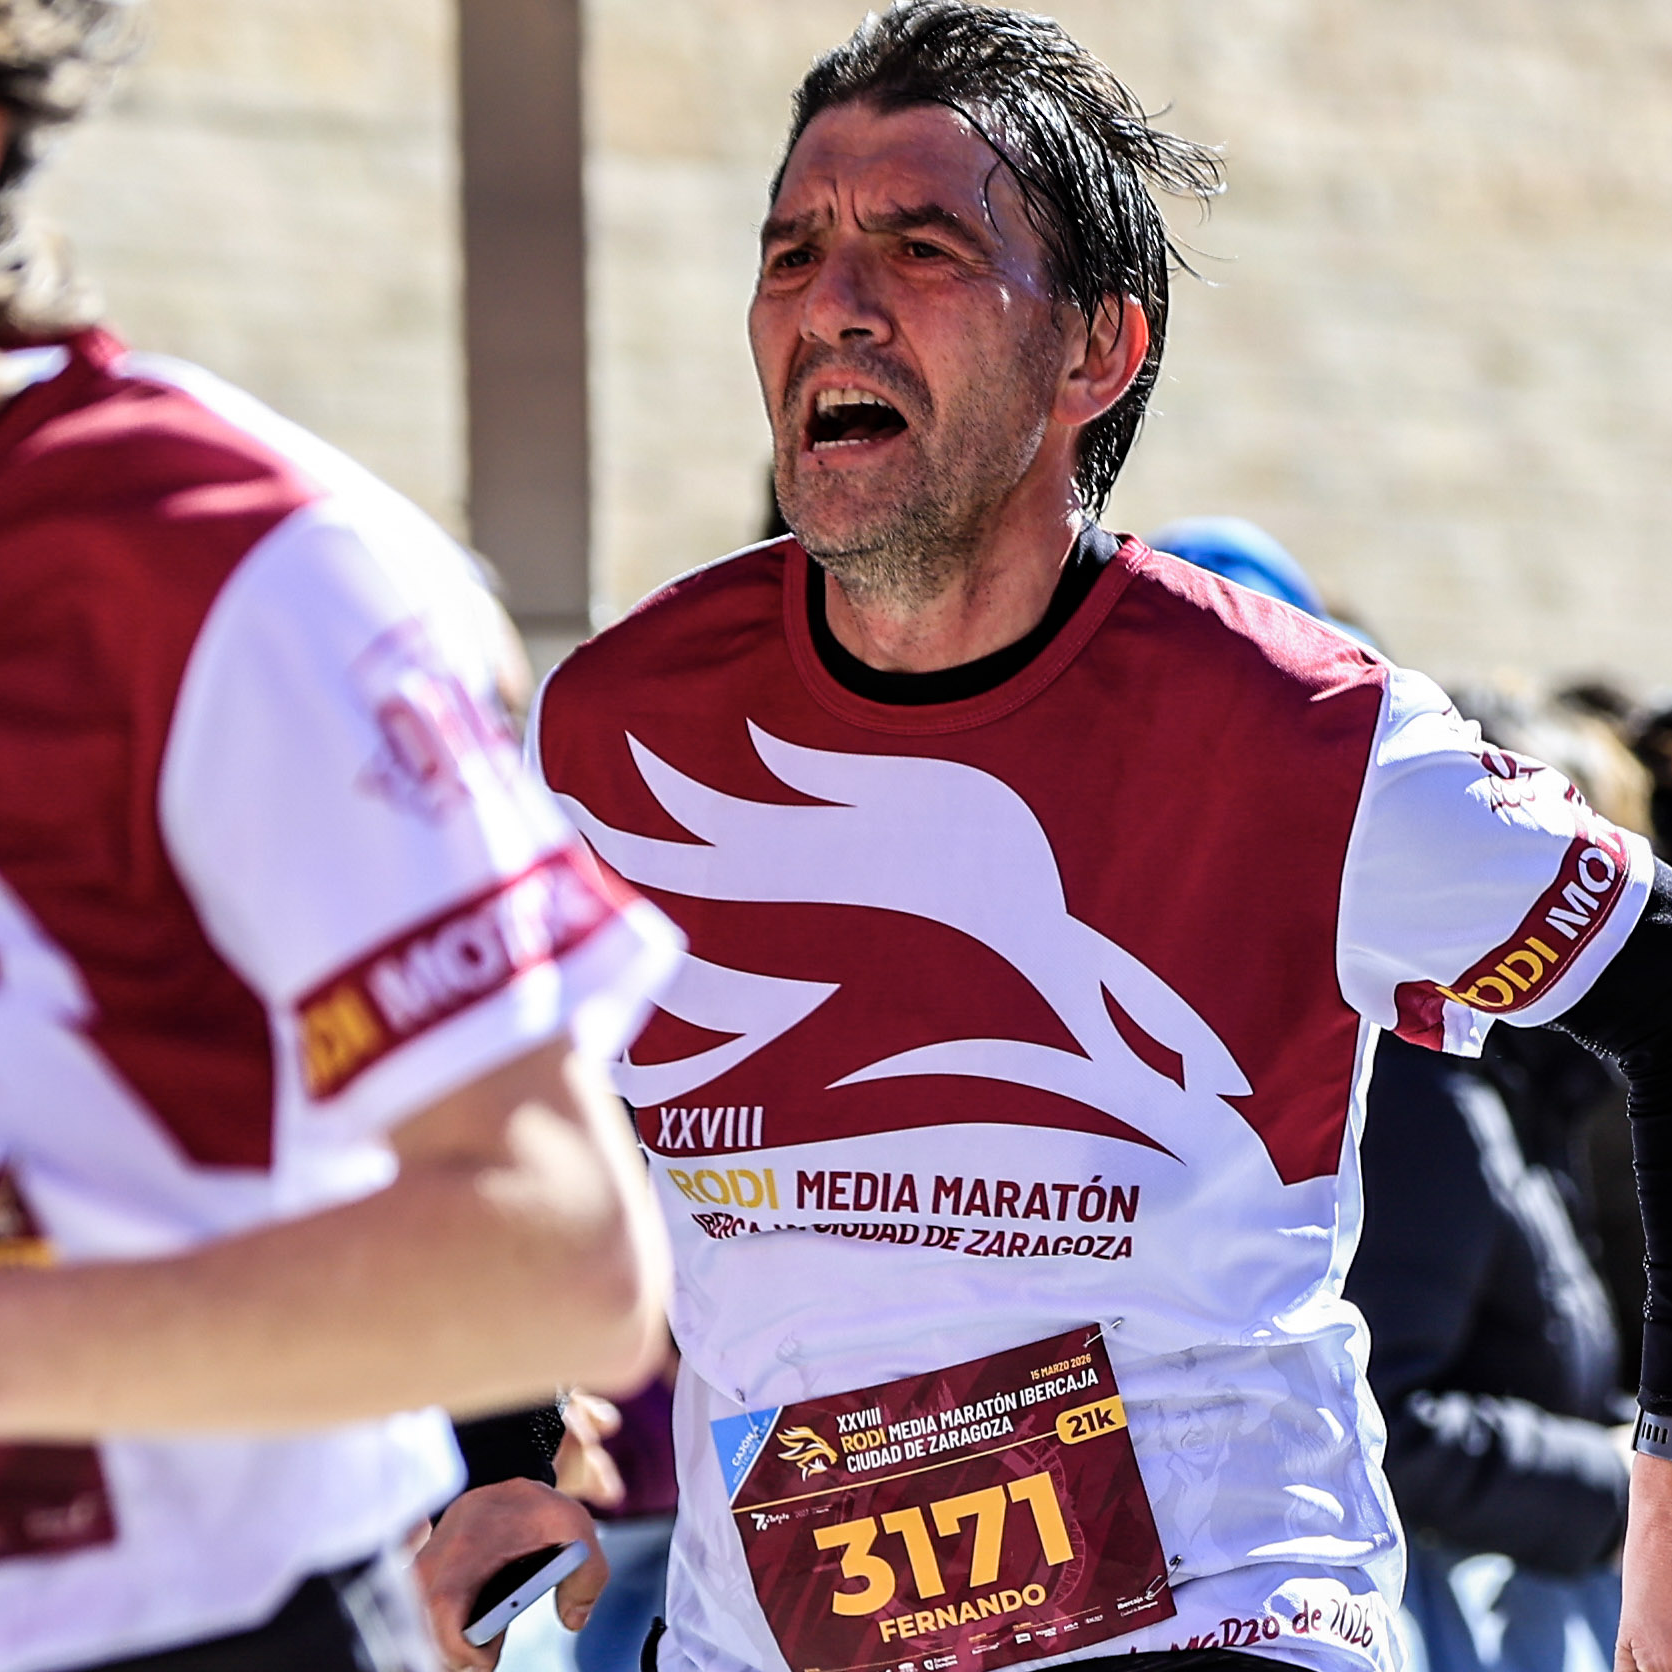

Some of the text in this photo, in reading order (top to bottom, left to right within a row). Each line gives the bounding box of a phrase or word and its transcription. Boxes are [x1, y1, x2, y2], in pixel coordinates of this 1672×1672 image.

[656, 1107, 764, 1149] XXVIII
[668, 1168, 1139, 1223] RODI MEDIA MARATÓN
[921, 1225, 965, 1252] DE
[963, 1229, 1132, 1261] ZARAGOZA
[1030, 1353, 1092, 1381] 15 MARZO 2026
[836, 1407, 882, 1433] XXVIII
[840, 1367, 1099, 1453] RODI MEDIA MARATÓN IBERCAJA
[1066, 1407, 1116, 1438] 21k
[846, 1416, 1014, 1473] CIUDAD DE ZARAGOZA
[813, 1470, 1074, 1616] 3171
[878, 1583, 1046, 1643] FERNANDO
[1291, 1599, 1322, 1634] de
[1329, 1599, 1374, 1648] 2026
